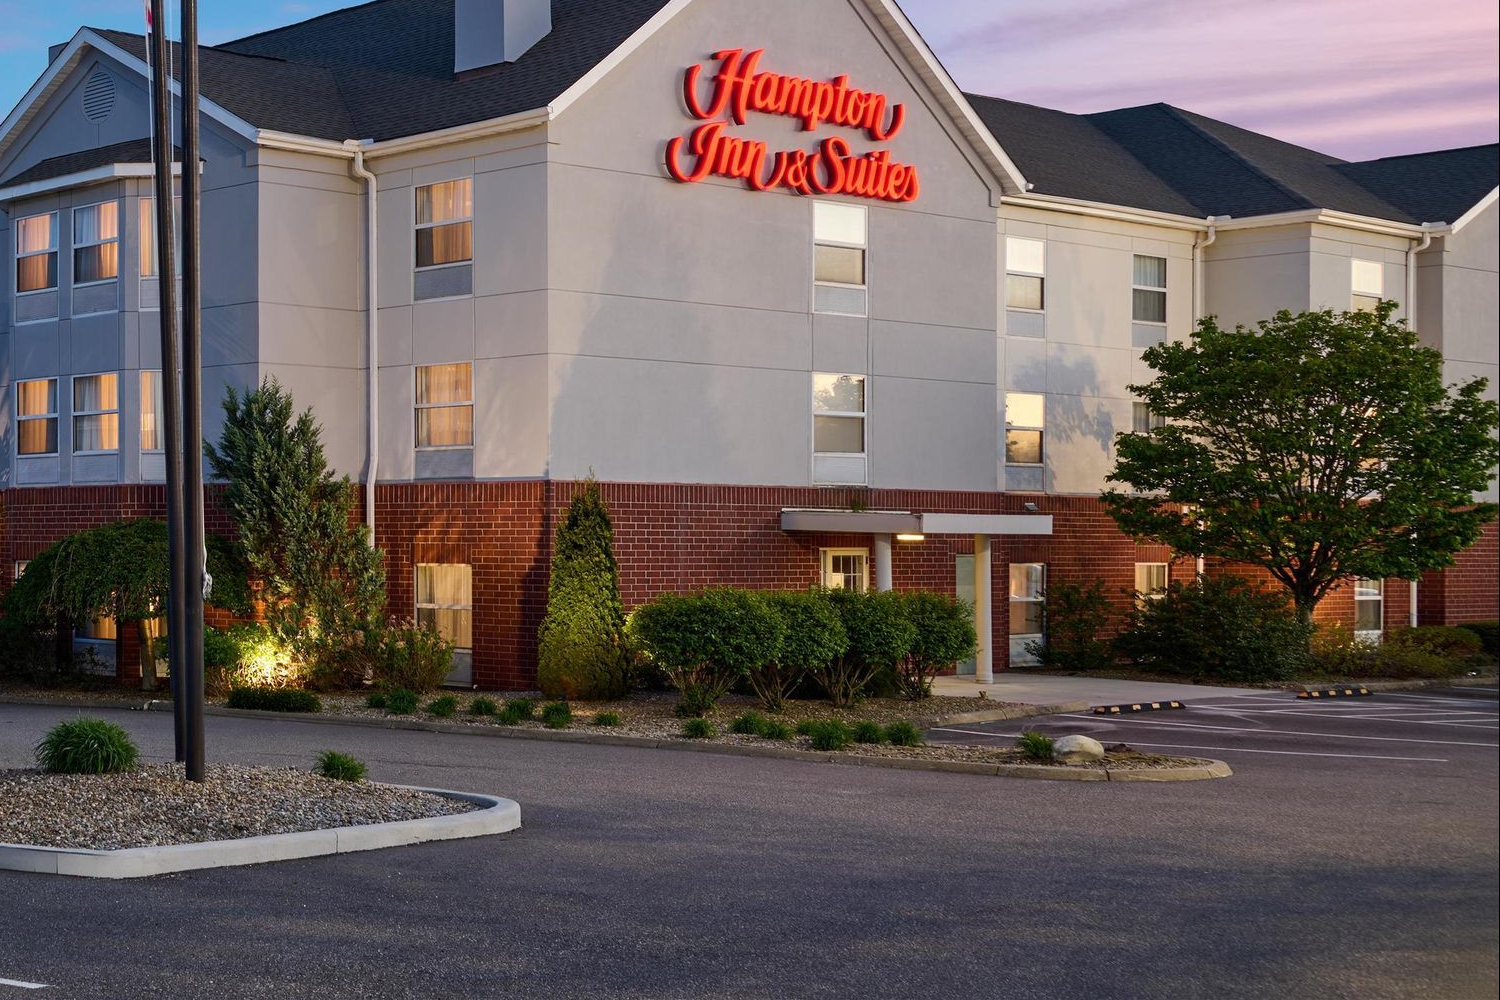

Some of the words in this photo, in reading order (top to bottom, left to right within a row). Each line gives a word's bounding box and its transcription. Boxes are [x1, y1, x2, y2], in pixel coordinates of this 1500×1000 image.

[684, 48, 905, 141] Hampton
[665, 121, 787, 191] Inn
[785, 149, 813, 196] &
[806, 136, 920, 202] Suites
